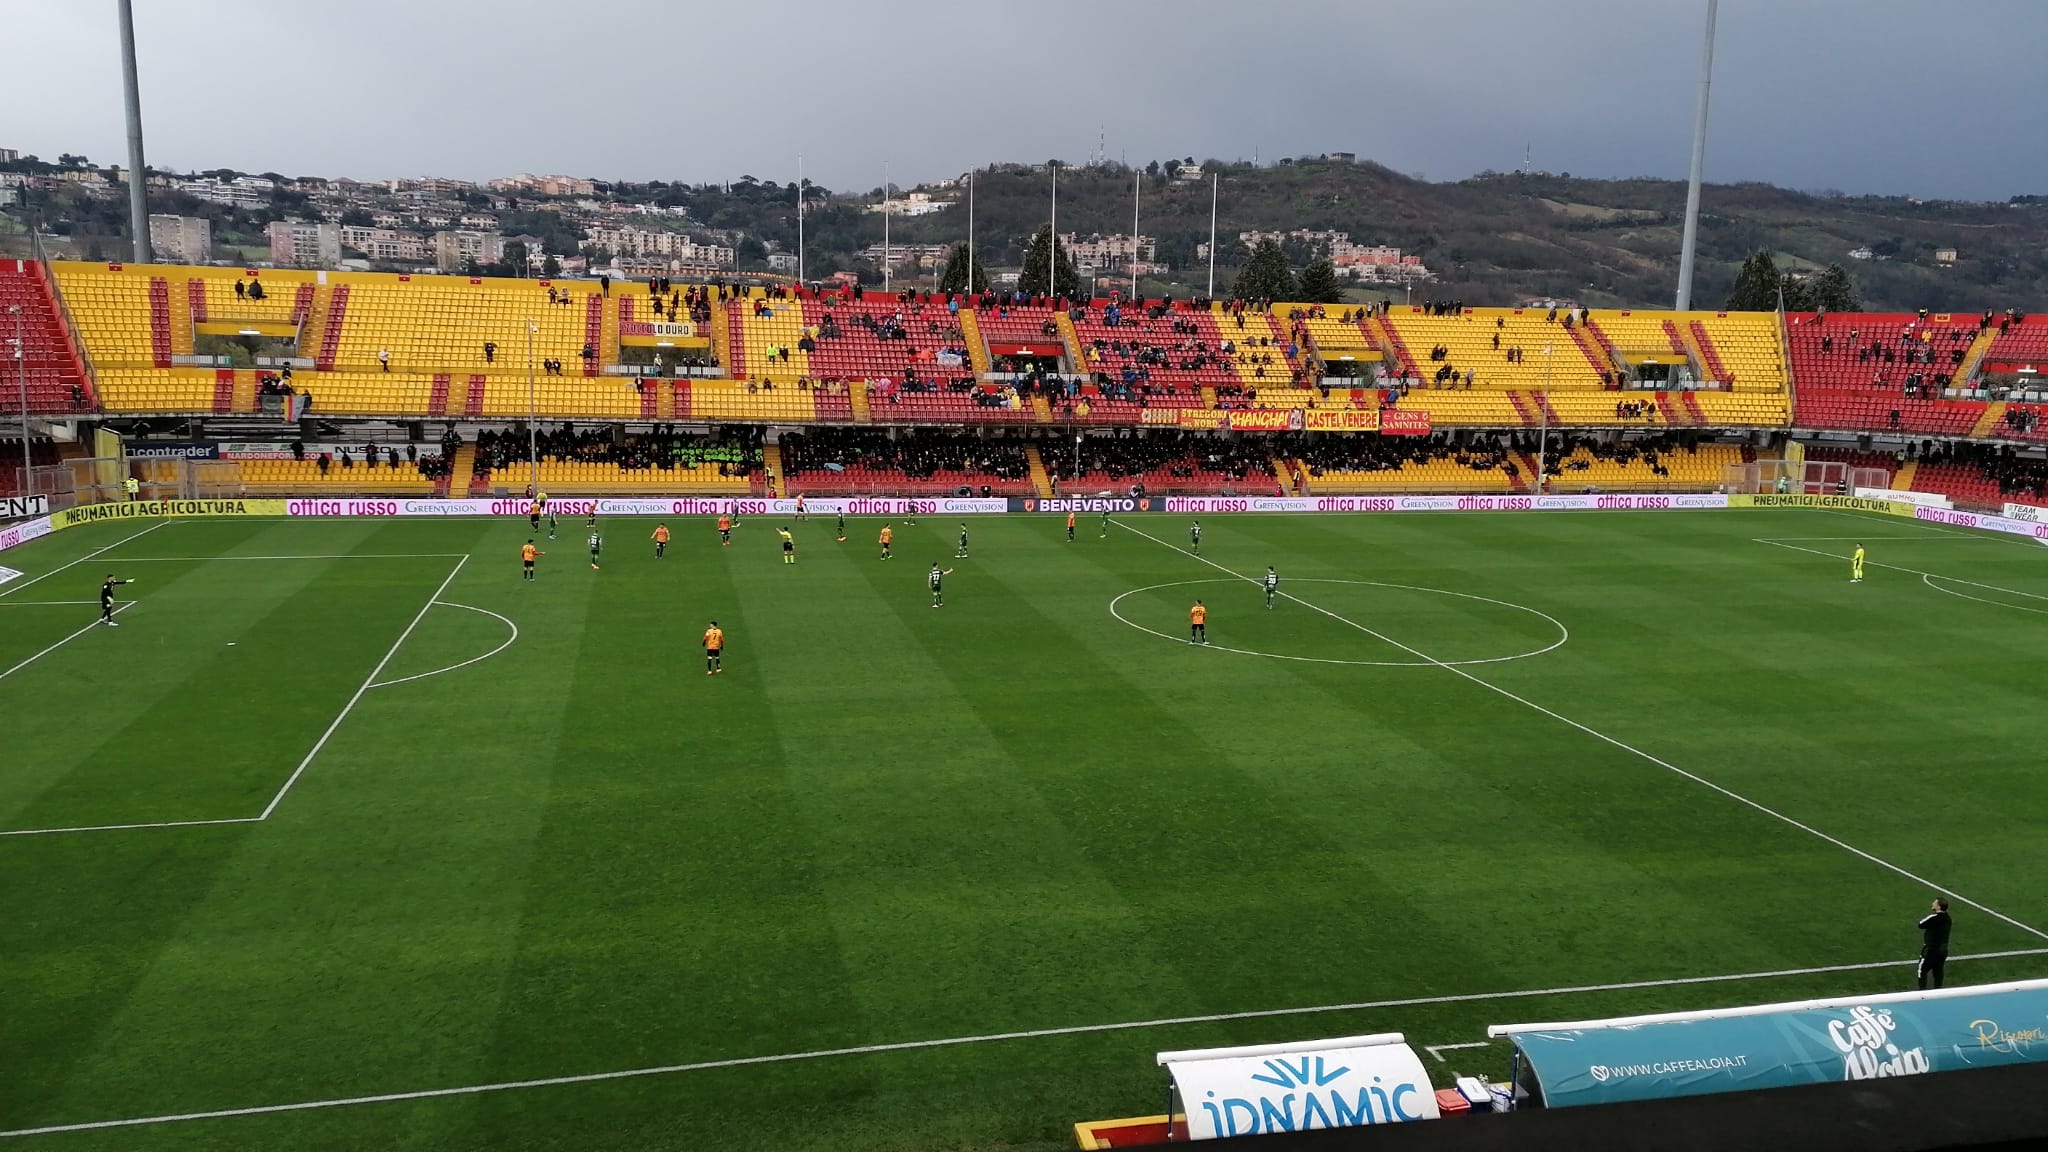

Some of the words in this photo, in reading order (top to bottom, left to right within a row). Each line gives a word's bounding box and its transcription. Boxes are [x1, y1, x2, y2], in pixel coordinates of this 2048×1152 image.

[1181, 409, 1228, 418] STREGONI
[1394, 412, 1418, 420] GENS
[1194, 419, 1218, 428] NORD
[1383, 421, 1429, 429] SAMNITES
[290, 498, 341, 515] ottica
[348, 501, 397, 516] russo
[405, 500, 477, 515] GREENVISION
[491, 498, 538, 515] ottic
[601, 500, 667, 515] GREENVISION
[673, 498, 717, 514] ottica
[849, 498, 890, 513] ottica
[944, 499, 1004, 513] GREENVISION
[1039, 499, 1134, 512] BENEVENTO
[1168, 497, 1206, 512] ottica
[1211, 499, 1248, 512] russo
[1253, 499, 1307, 512] GREENVISION
[1318, 496, 1354, 511] ottica
[1359, 498, 1395, 511] russo
[1457, 495, 1493, 510] ottica
[1498, 497, 1532, 510] russo
[1597, 494, 1631, 509] ottica
[1636, 496, 1670, 509] russo
[1753, 495, 1813, 506] PNEUMATICI
[1815, 496, 1891, 513] AGRICOLTURA
[66, 505, 135, 526] PNEUMATICI
[138, 501, 246, 516] AGRICOLTURA
[1916, 505, 1945, 521] ottica
[1948, 509, 1977, 528] russo
[2014, 504, 2036, 515] TEAM
[2014, 512, 2039, 521] WEAR
[1, 530, 20, 549] russo
[1610, 1055, 1747, 1077] WWW.CAFFEALOIA.IT
